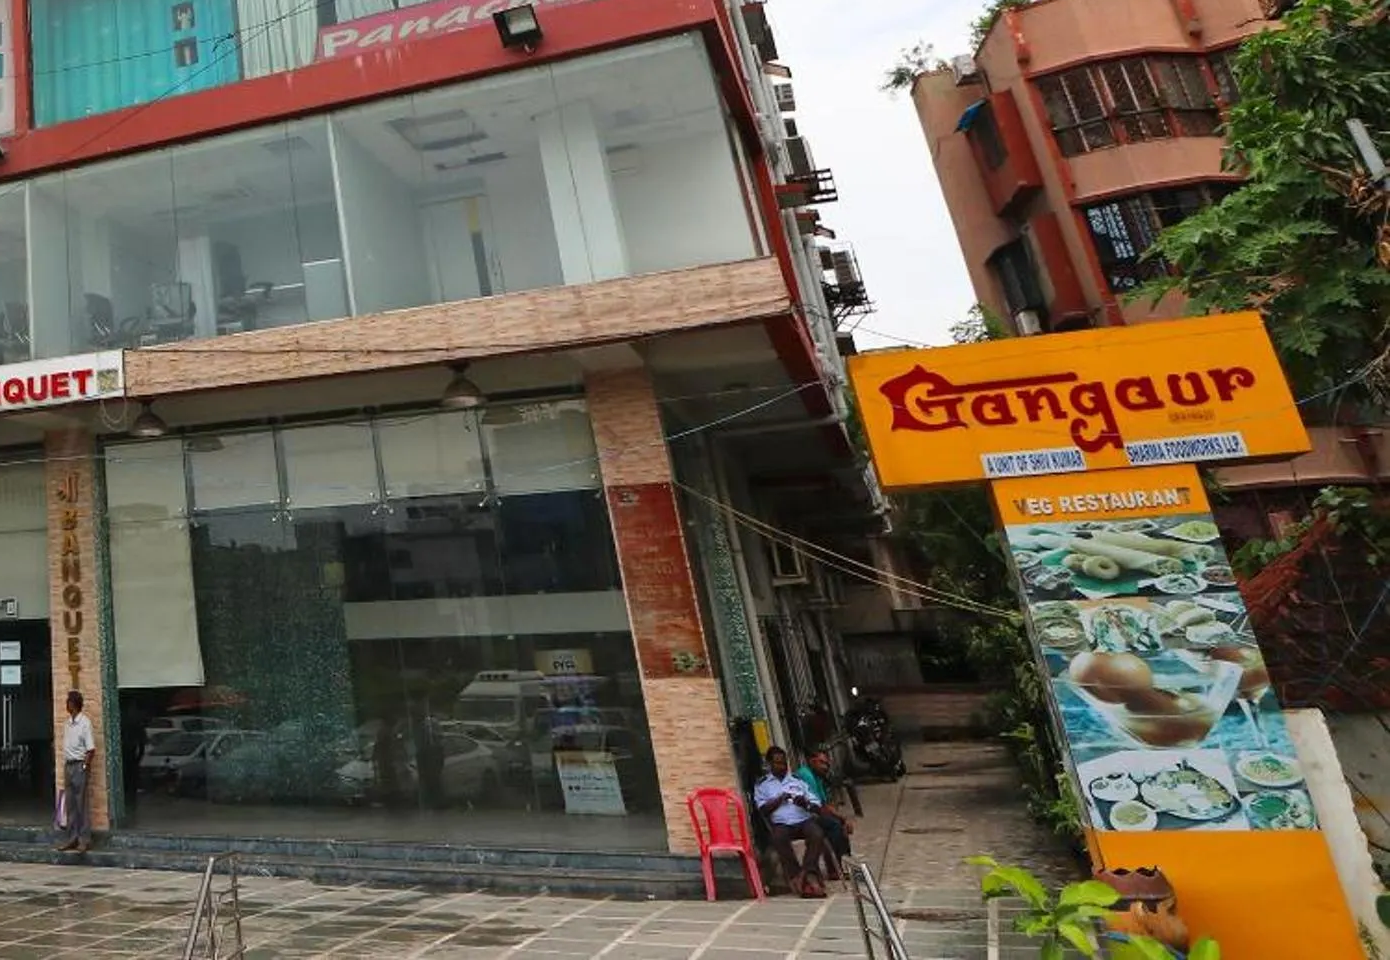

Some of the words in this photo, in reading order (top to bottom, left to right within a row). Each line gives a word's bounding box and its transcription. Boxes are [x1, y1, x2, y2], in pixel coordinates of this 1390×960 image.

[879, 365, 1256, 453] Gangaur
[996, 456, 1017, 473] UNIT
[1018, 455, 1030, 472] OF
[1030, 453, 1051, 470] SHIV
[1052, 450, 1085, 468] KUMAR
[1126, 442, 1163, 464] SHARMA
[1164, 436, 1223, 461] FOODWORKS
[61, 507, 83, 689] BANQUET
